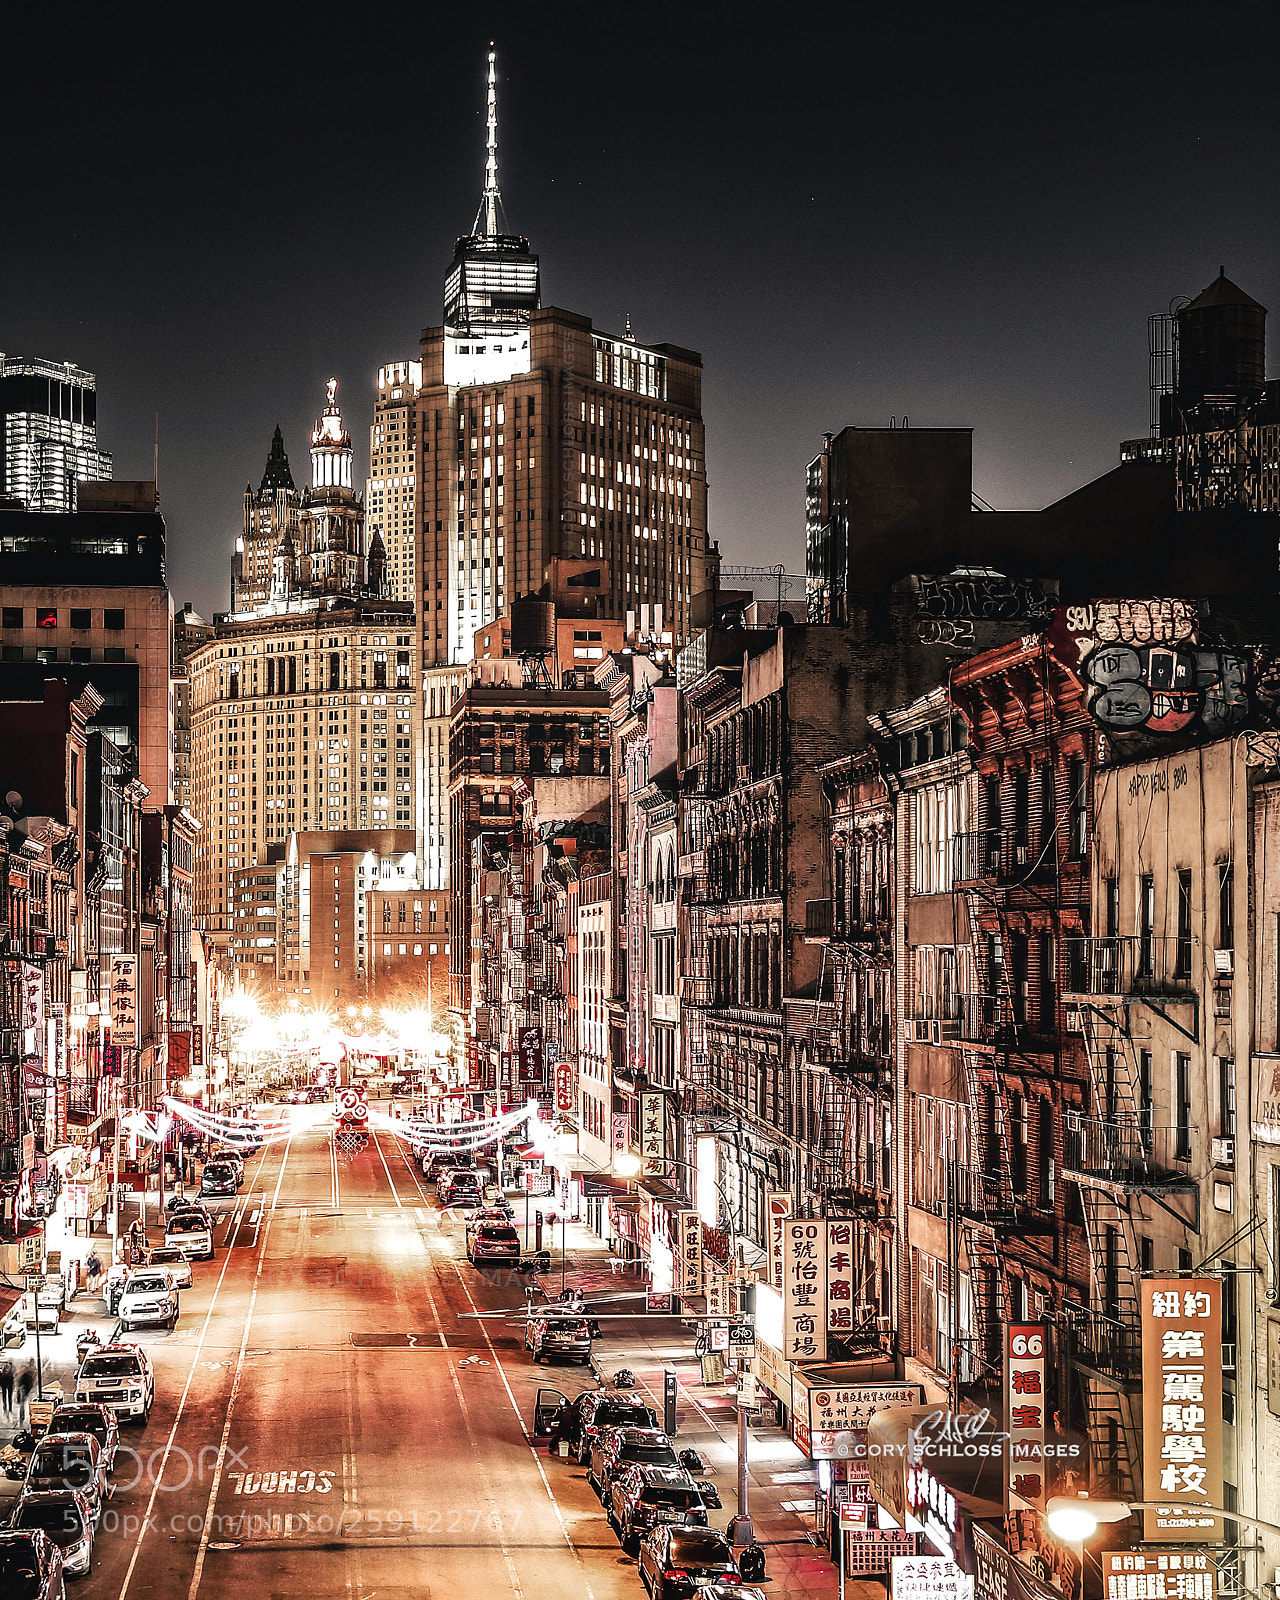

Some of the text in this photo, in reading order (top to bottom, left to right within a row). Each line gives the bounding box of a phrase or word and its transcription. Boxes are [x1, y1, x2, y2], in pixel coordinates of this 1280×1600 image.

[645, 1097, 662, 1174] 華美商場
[1152, 1290, 1211, 1319] 紐約
[1012, 1334, 1044, 1356] 66
[1160, 1330, 1208, 1496] 第一駕駛學校
[228, 1470, 336, 1495] SCHOOL
[977, 1556, 1008, 1600] LEASE
[996, 1554, 1009, 1577] FOR
[1029, 1556, 1045, 1582] 66
